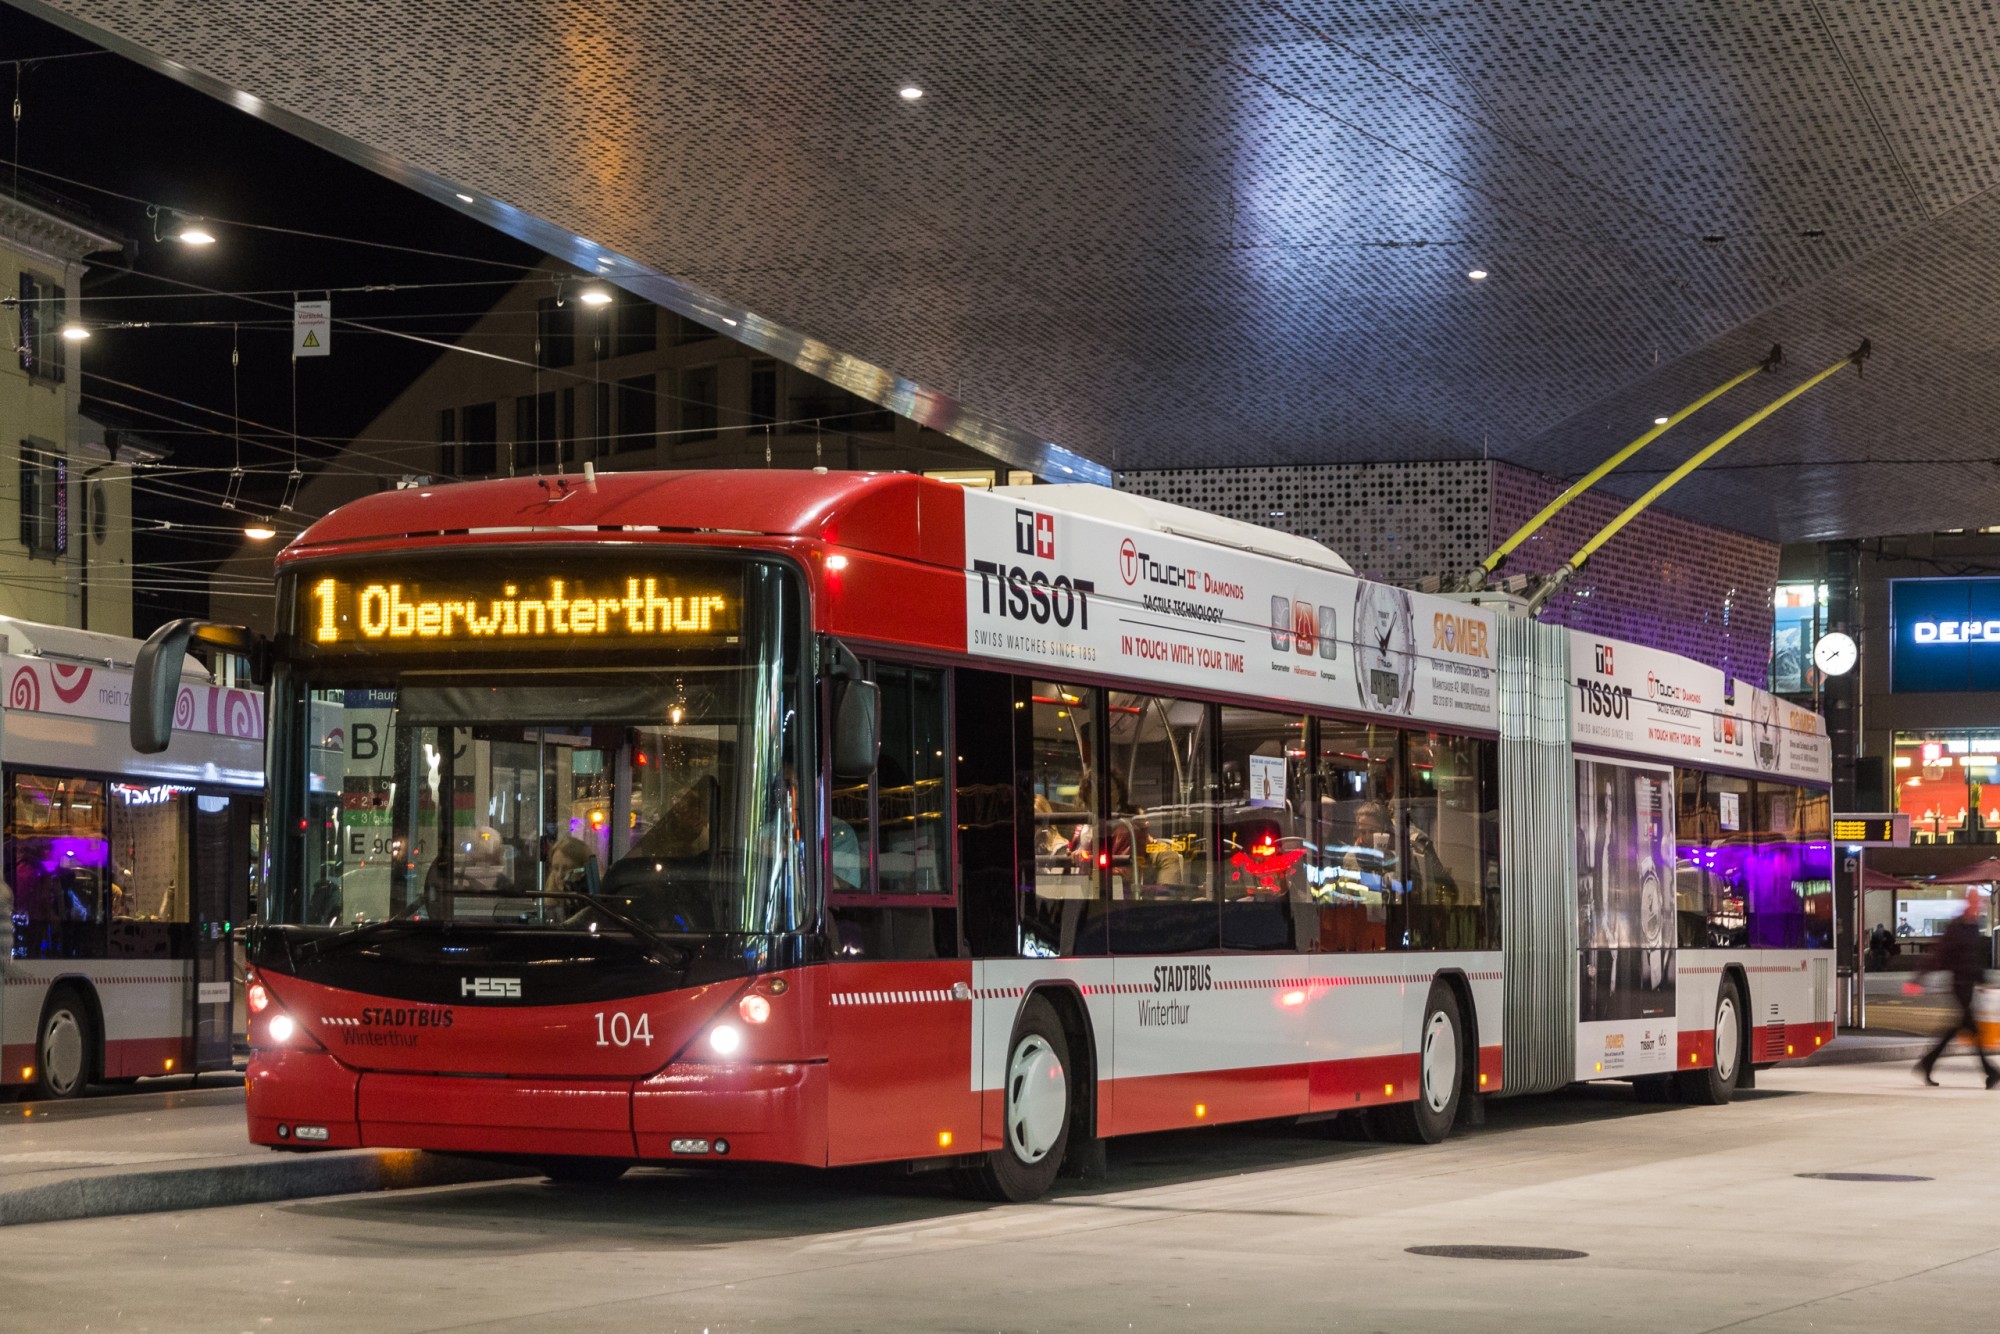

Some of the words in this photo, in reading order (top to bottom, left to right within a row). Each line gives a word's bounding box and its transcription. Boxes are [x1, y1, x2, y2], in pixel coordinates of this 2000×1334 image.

[974, 559, 1095, 630] TISSOT
[1142, 594, 1172, 614] TACTILE
[1173, 600, 1224, 624] TECHNOLOGY
[315, 579, 338, 642] 1
[361, 578, 725, 636] Oberwinterthur
[974, 629, 1003, 647] SWISS
[1007, 635, 1046, 654] WATCHES
[1050, 641, 1075, 658] SINCE
[1079, 646, 1096, 662] 1853
[1121, 635, 1133, 655] IN
[1135, 637, 1168, 661] TOUCH
[1170, 643, 1194, 665] WITH
[1197, 647, 1222, 669] YOUR
[1224, 652, 1244, 673] TIME
[99, 686, 121, 706] mein
[1577, 678, 1632, 720] TISSOT
[351, 723, 379, 760] B
[361, 796, 368, 807] 2
[361, 813, 368, 824] 3
[351, 833, 365, 854] E
[461, 977, 521, 997] HESS
[1154, 964, 1211, 993] STADTBUS
[362, 1007, 453, 1027] STADTBUS
[1138, 998, 1190, 1027] Winterthur
[341, 1028, 418, 1047] Winterthur
[594, 1012, 654, 1046] 104
